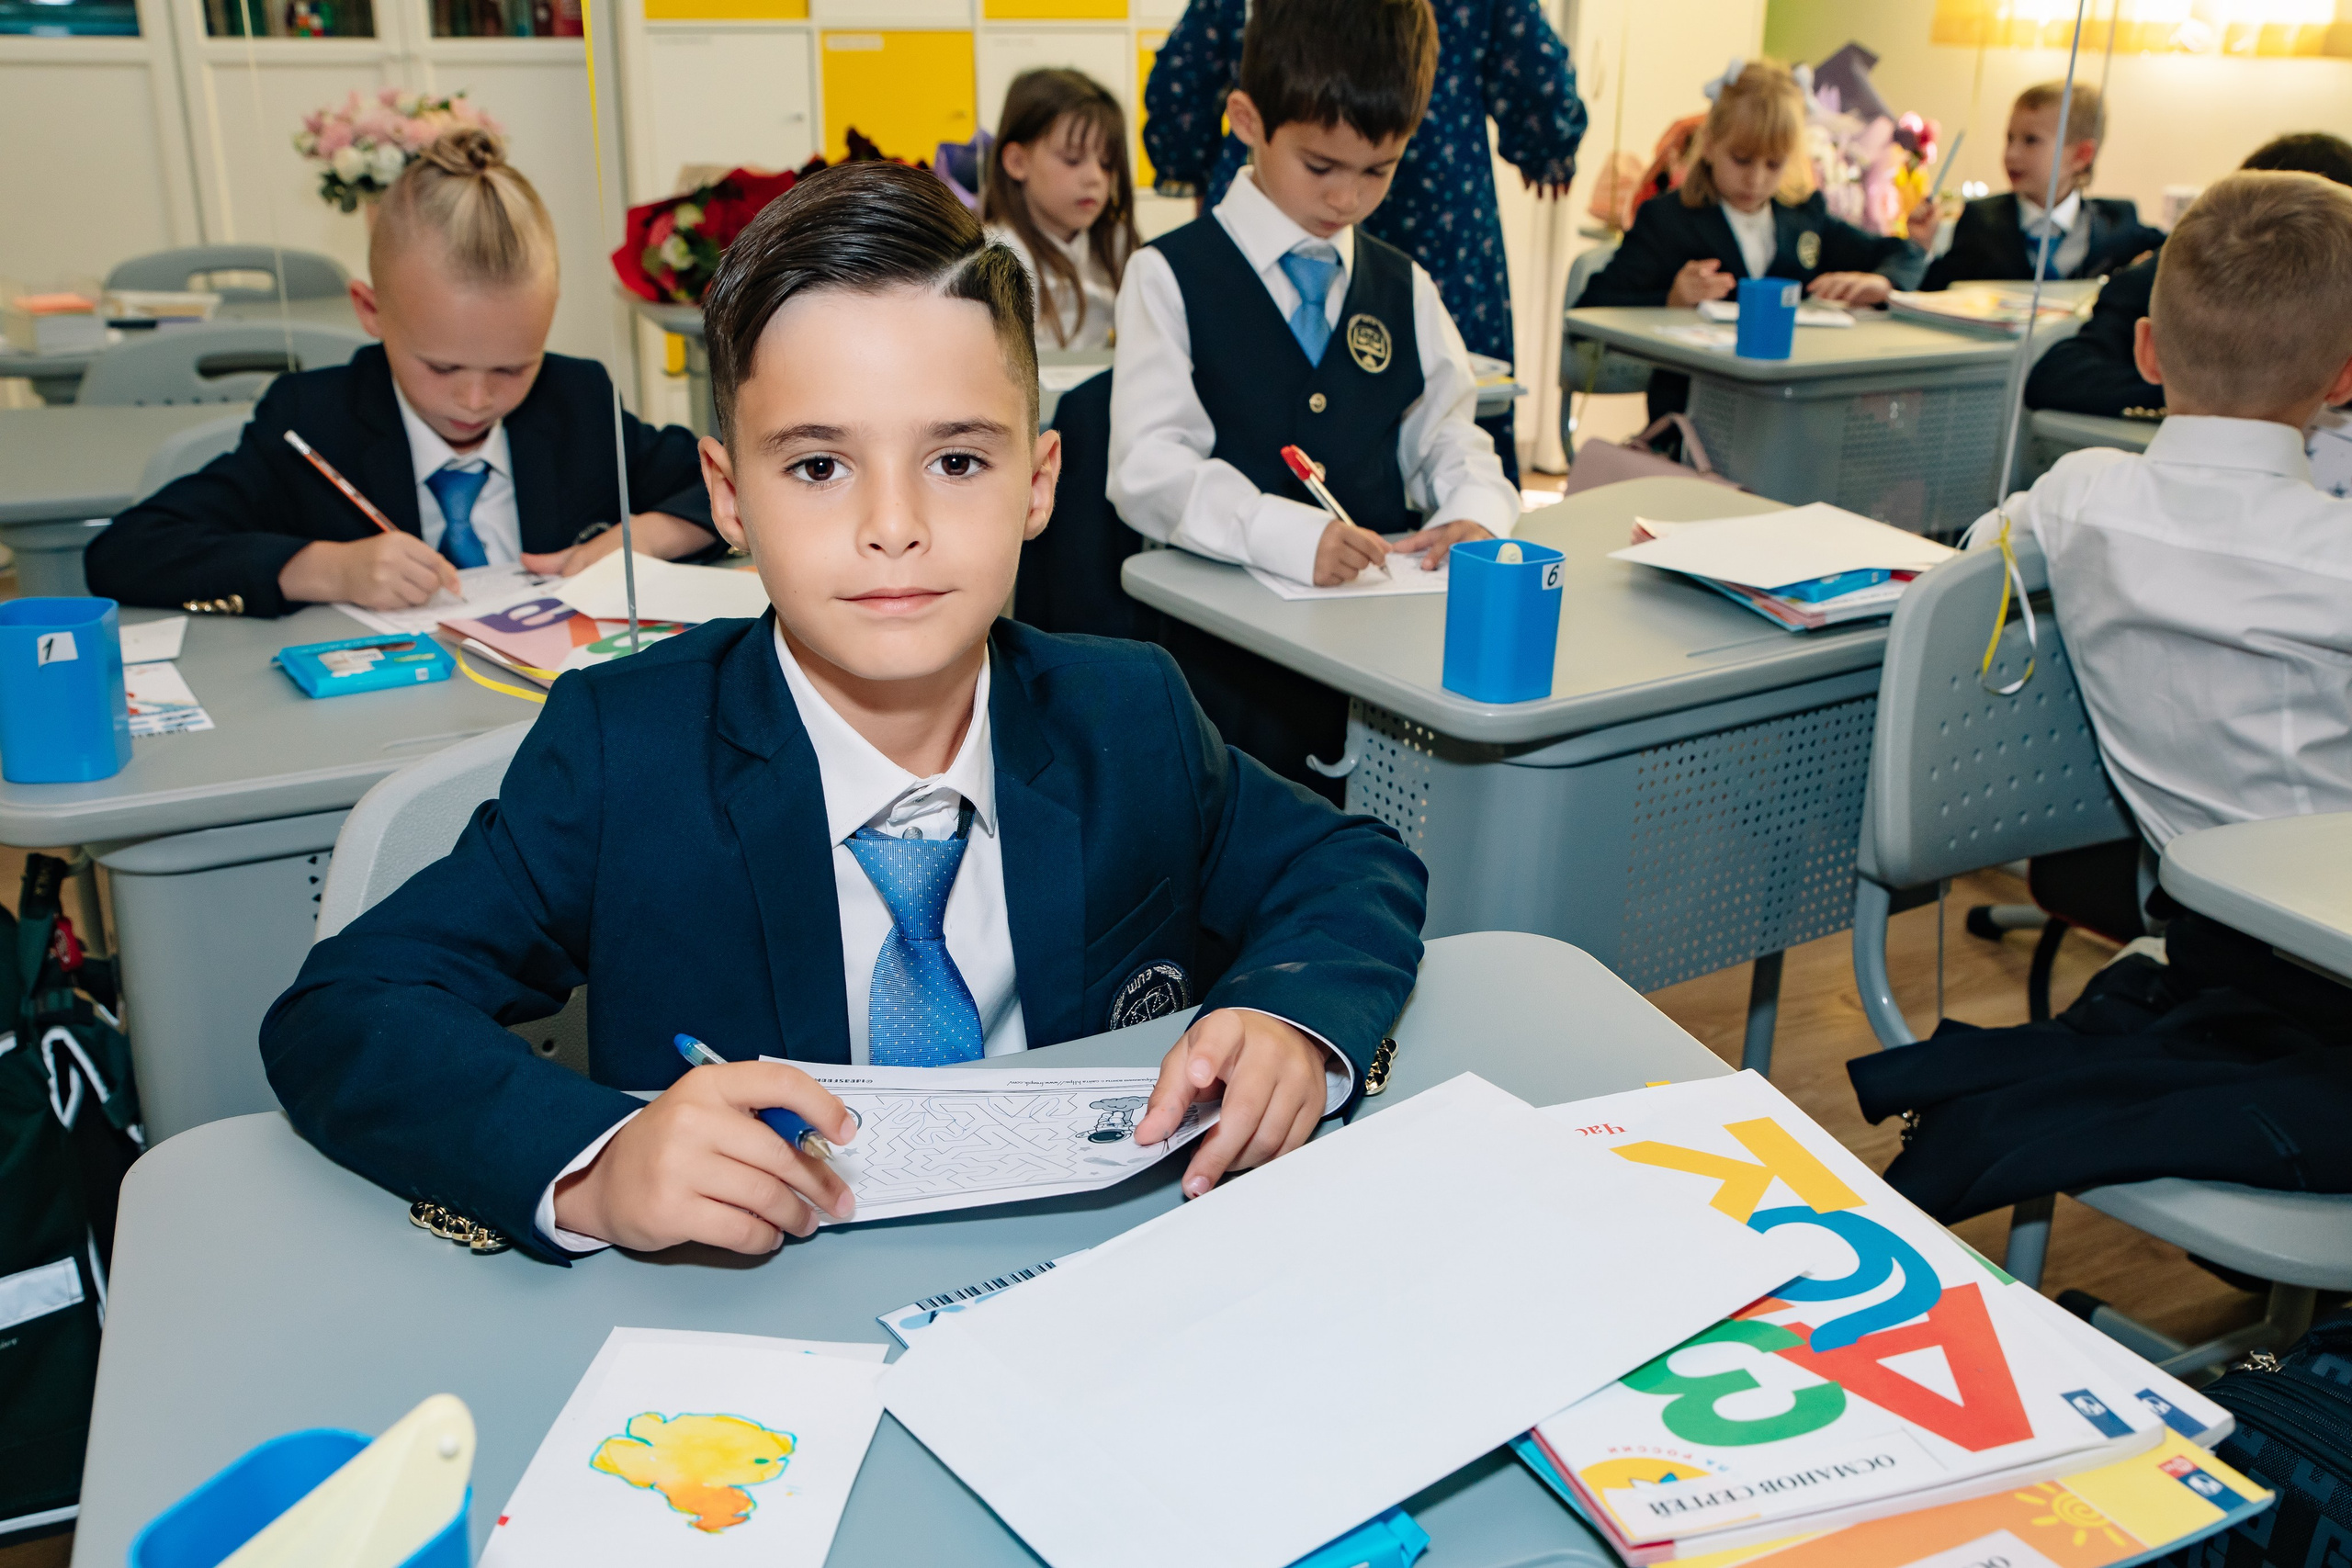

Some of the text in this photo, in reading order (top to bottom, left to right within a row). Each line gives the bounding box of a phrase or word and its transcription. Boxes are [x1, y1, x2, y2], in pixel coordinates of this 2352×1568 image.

[42, 637, 54, 660] 1
[1574, 1122, 1628, 1136] Час
[1608, 1445, 1693, 1460] РОССИИ
[1547, 1483, 1560, 1506] 6
[1648, 1453, 1896, 1518] ОСМАНОВ СЕРГЕЙ
